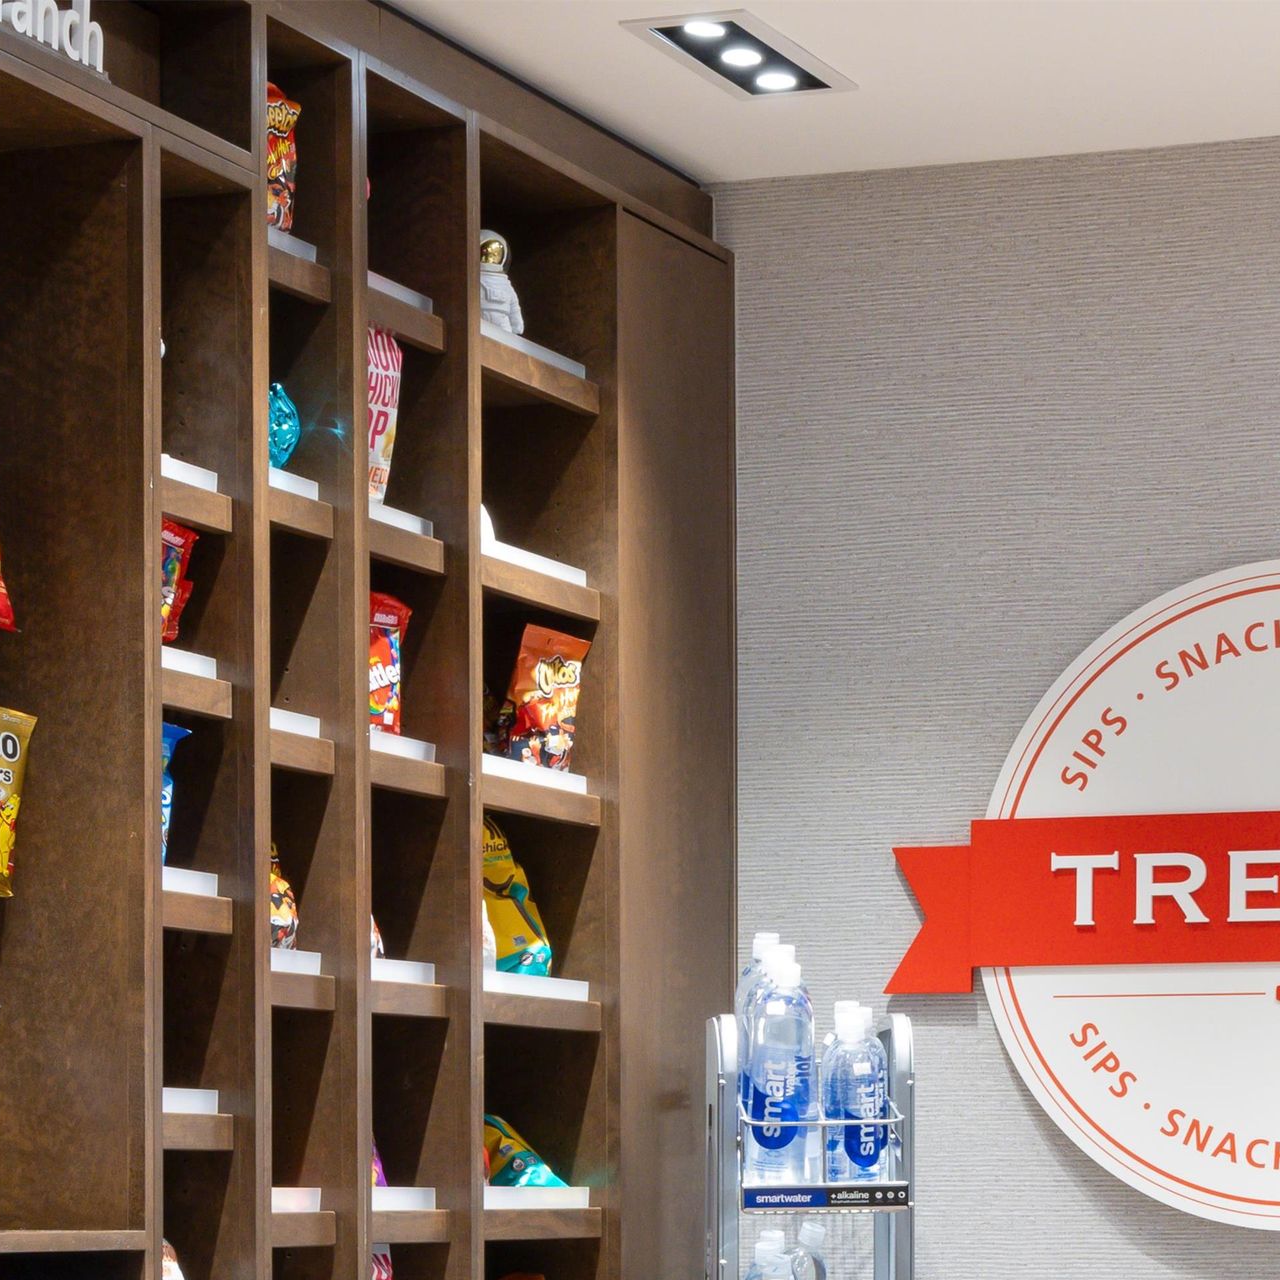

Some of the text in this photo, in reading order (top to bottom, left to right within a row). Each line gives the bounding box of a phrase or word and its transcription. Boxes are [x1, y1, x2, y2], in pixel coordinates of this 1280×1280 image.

[369, 372, 400, 409] HICK
[1060, 707, 1127, 792] SIPS
[1069, 1020, 1138, 1098] SIPS
[763, 1061, 786, 1138] smart
[856, 1083, 876, 1156] smart
[756, 1194, 812, 1204] smartwater
